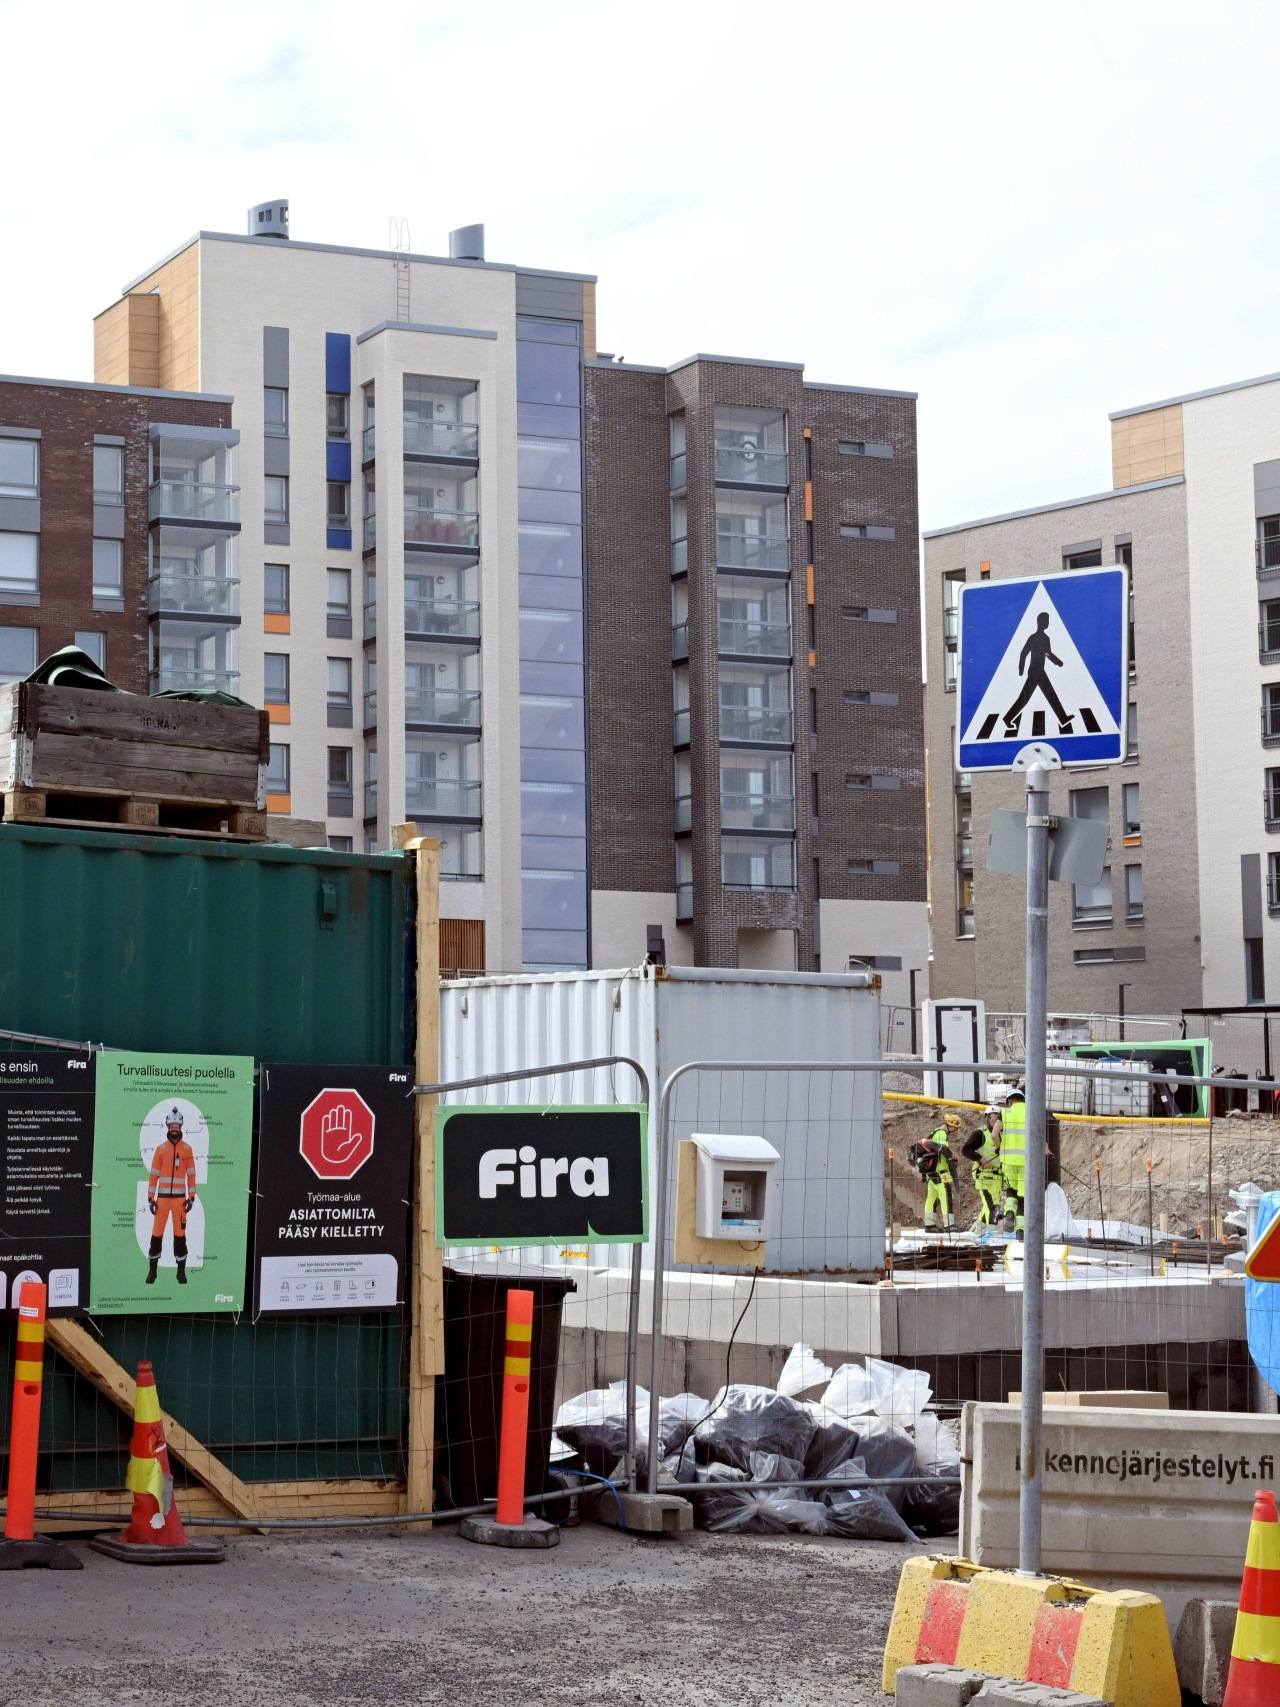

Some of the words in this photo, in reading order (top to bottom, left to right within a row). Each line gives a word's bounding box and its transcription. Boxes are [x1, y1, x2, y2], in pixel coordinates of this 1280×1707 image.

[8, 1060, 38, 1072] ensin
[67, 1059, 86, 1068] Fira
[116, 1063, 192, 1077] Turvallisuutesi
[194, 1066, 234, 1080] puolella
[388, 1073, 406, 1081] Fira
[28, 1076, 53, 1084] ehdoilla
[479, 1145, 610, 1199] Fira
[307, 1192, 360, 1203] Työmaa-alue
[288, 1208, 375, 1220] ASIATTOMILTA
[278, 1224, 317, 1238] PÄÄSY
[320, 1225, 384, 1237] KIELLETTY
[13, 1253, 42, 1261] epäkohtia:
[214, 1293, 233, 1302] Fira
